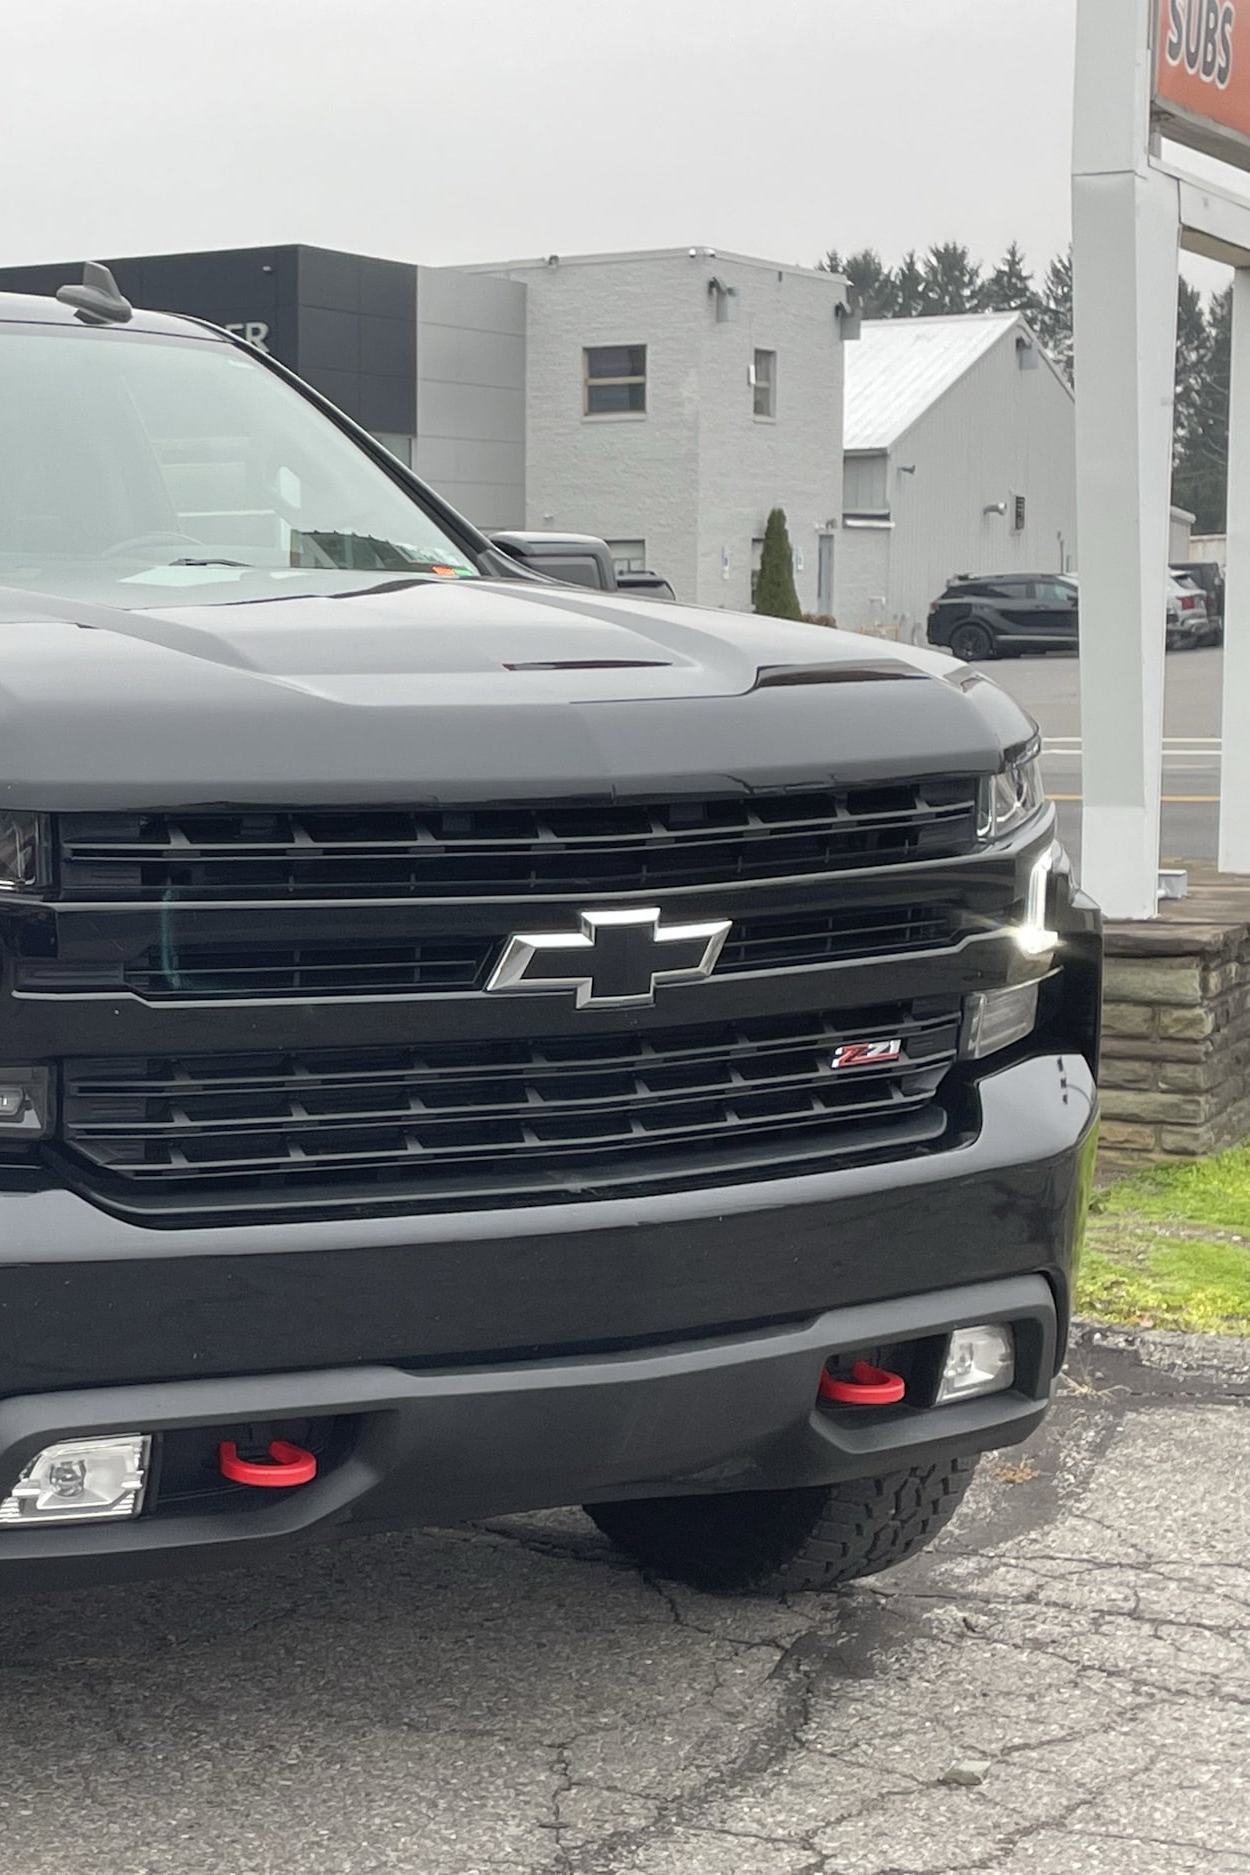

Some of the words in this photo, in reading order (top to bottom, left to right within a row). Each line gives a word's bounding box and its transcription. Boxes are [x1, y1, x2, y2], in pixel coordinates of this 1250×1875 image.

[1165, 0, 1235, 90] SUBS
[225, 321, 270, 353] R
[831, 1039, 902, 1069] Z71
